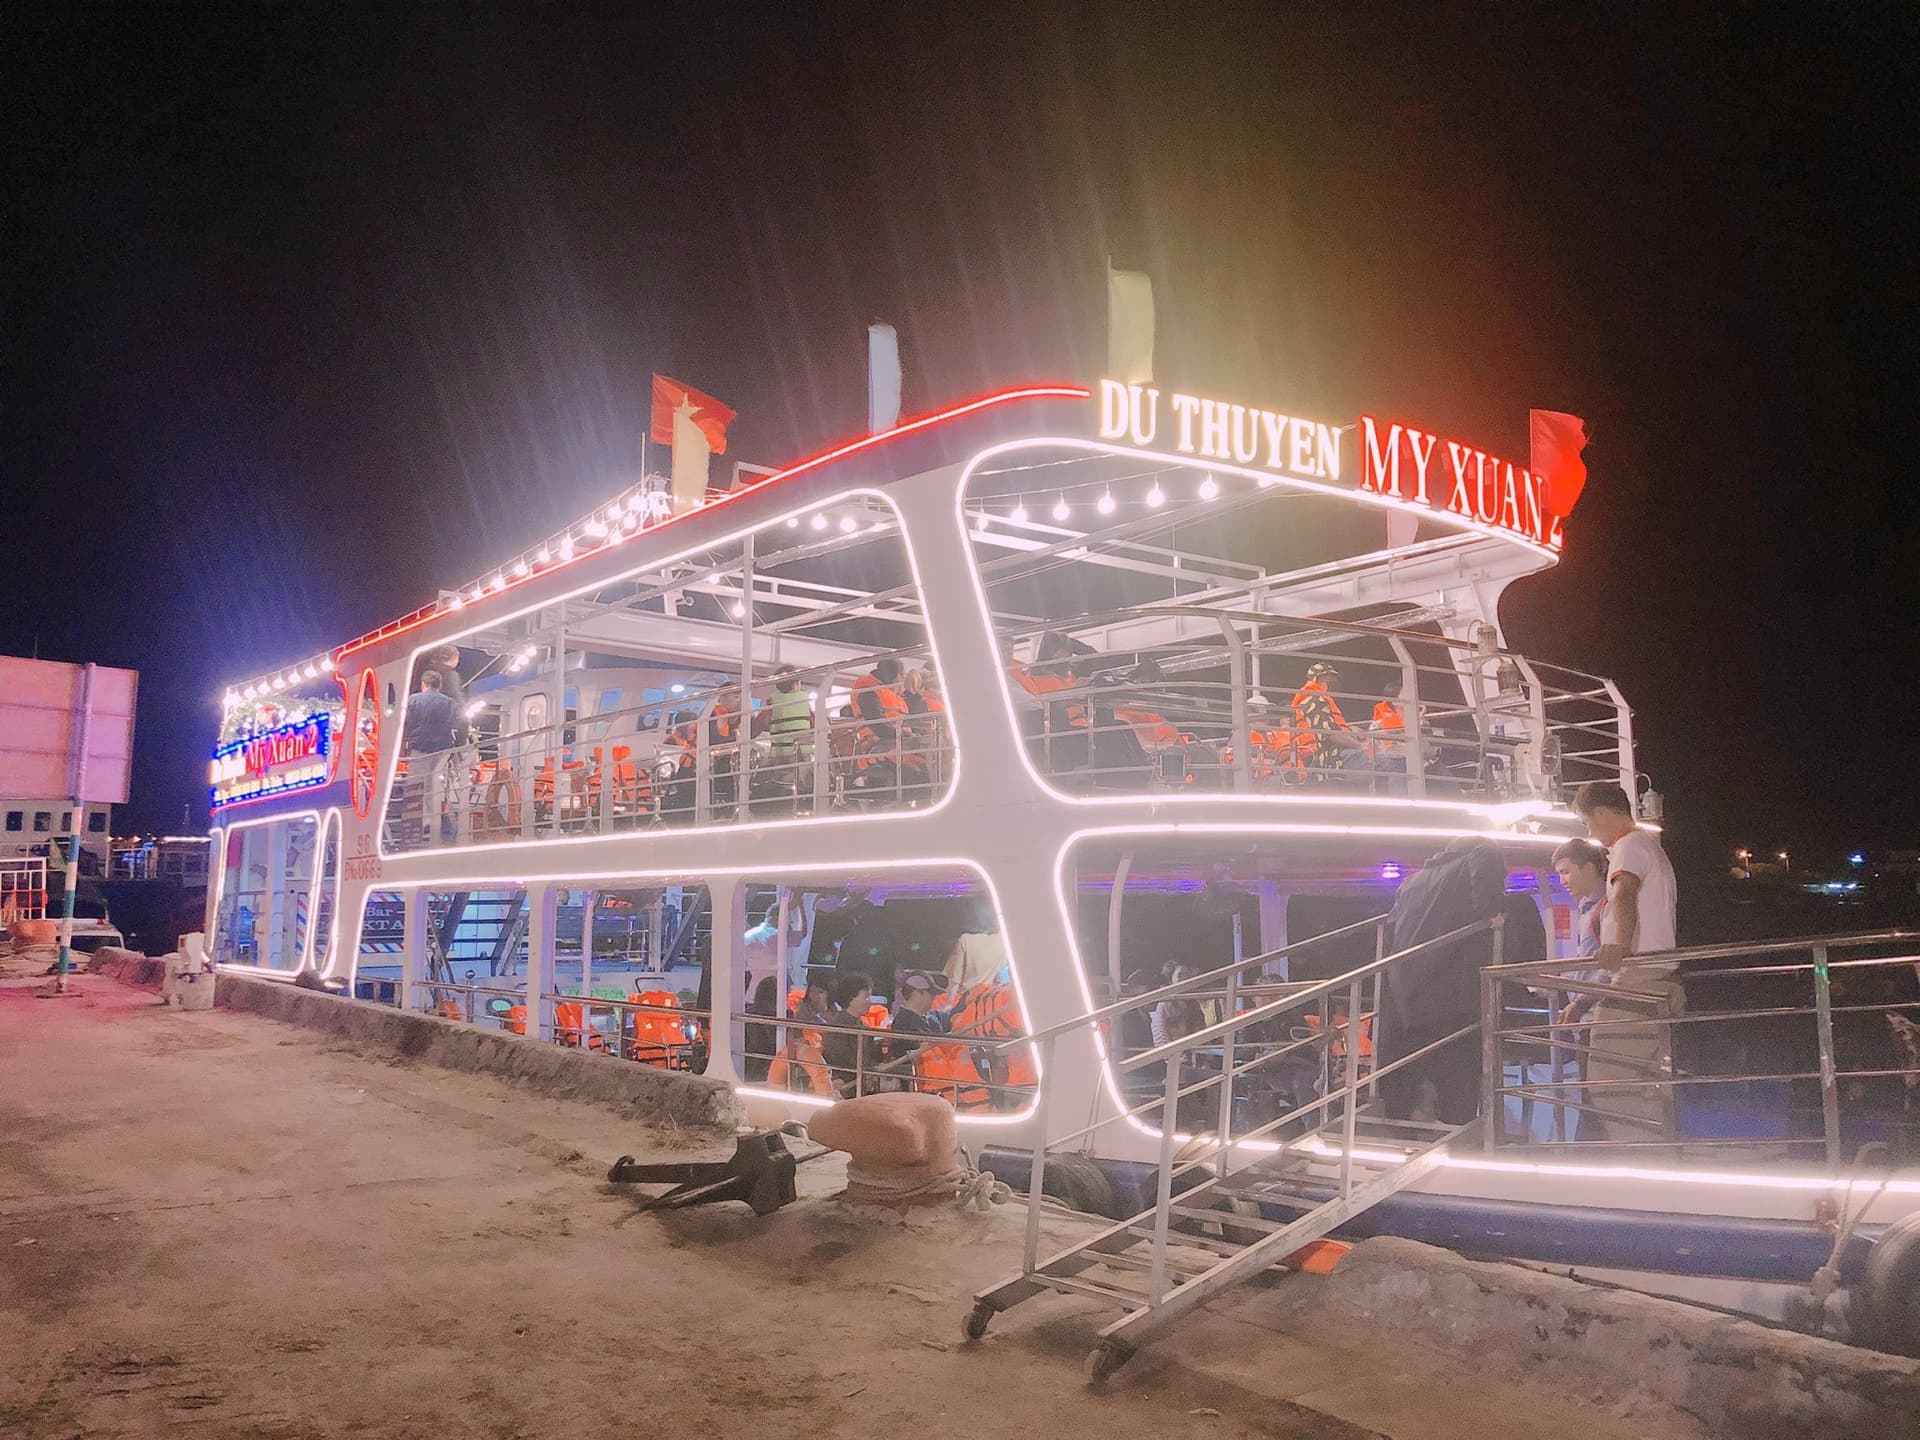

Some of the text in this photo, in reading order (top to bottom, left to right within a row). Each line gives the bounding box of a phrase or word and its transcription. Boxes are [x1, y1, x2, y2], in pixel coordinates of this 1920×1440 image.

[1099, 378, 1160, 446] DU
[1172, 393, 1342, 481] THUYEN
[1361, 416, 1437, 504] MY
[1447, 441, 1543, 541] XUAN
[307, 724, 318, 754] 2
[366, 907, 393, 917] Bar
